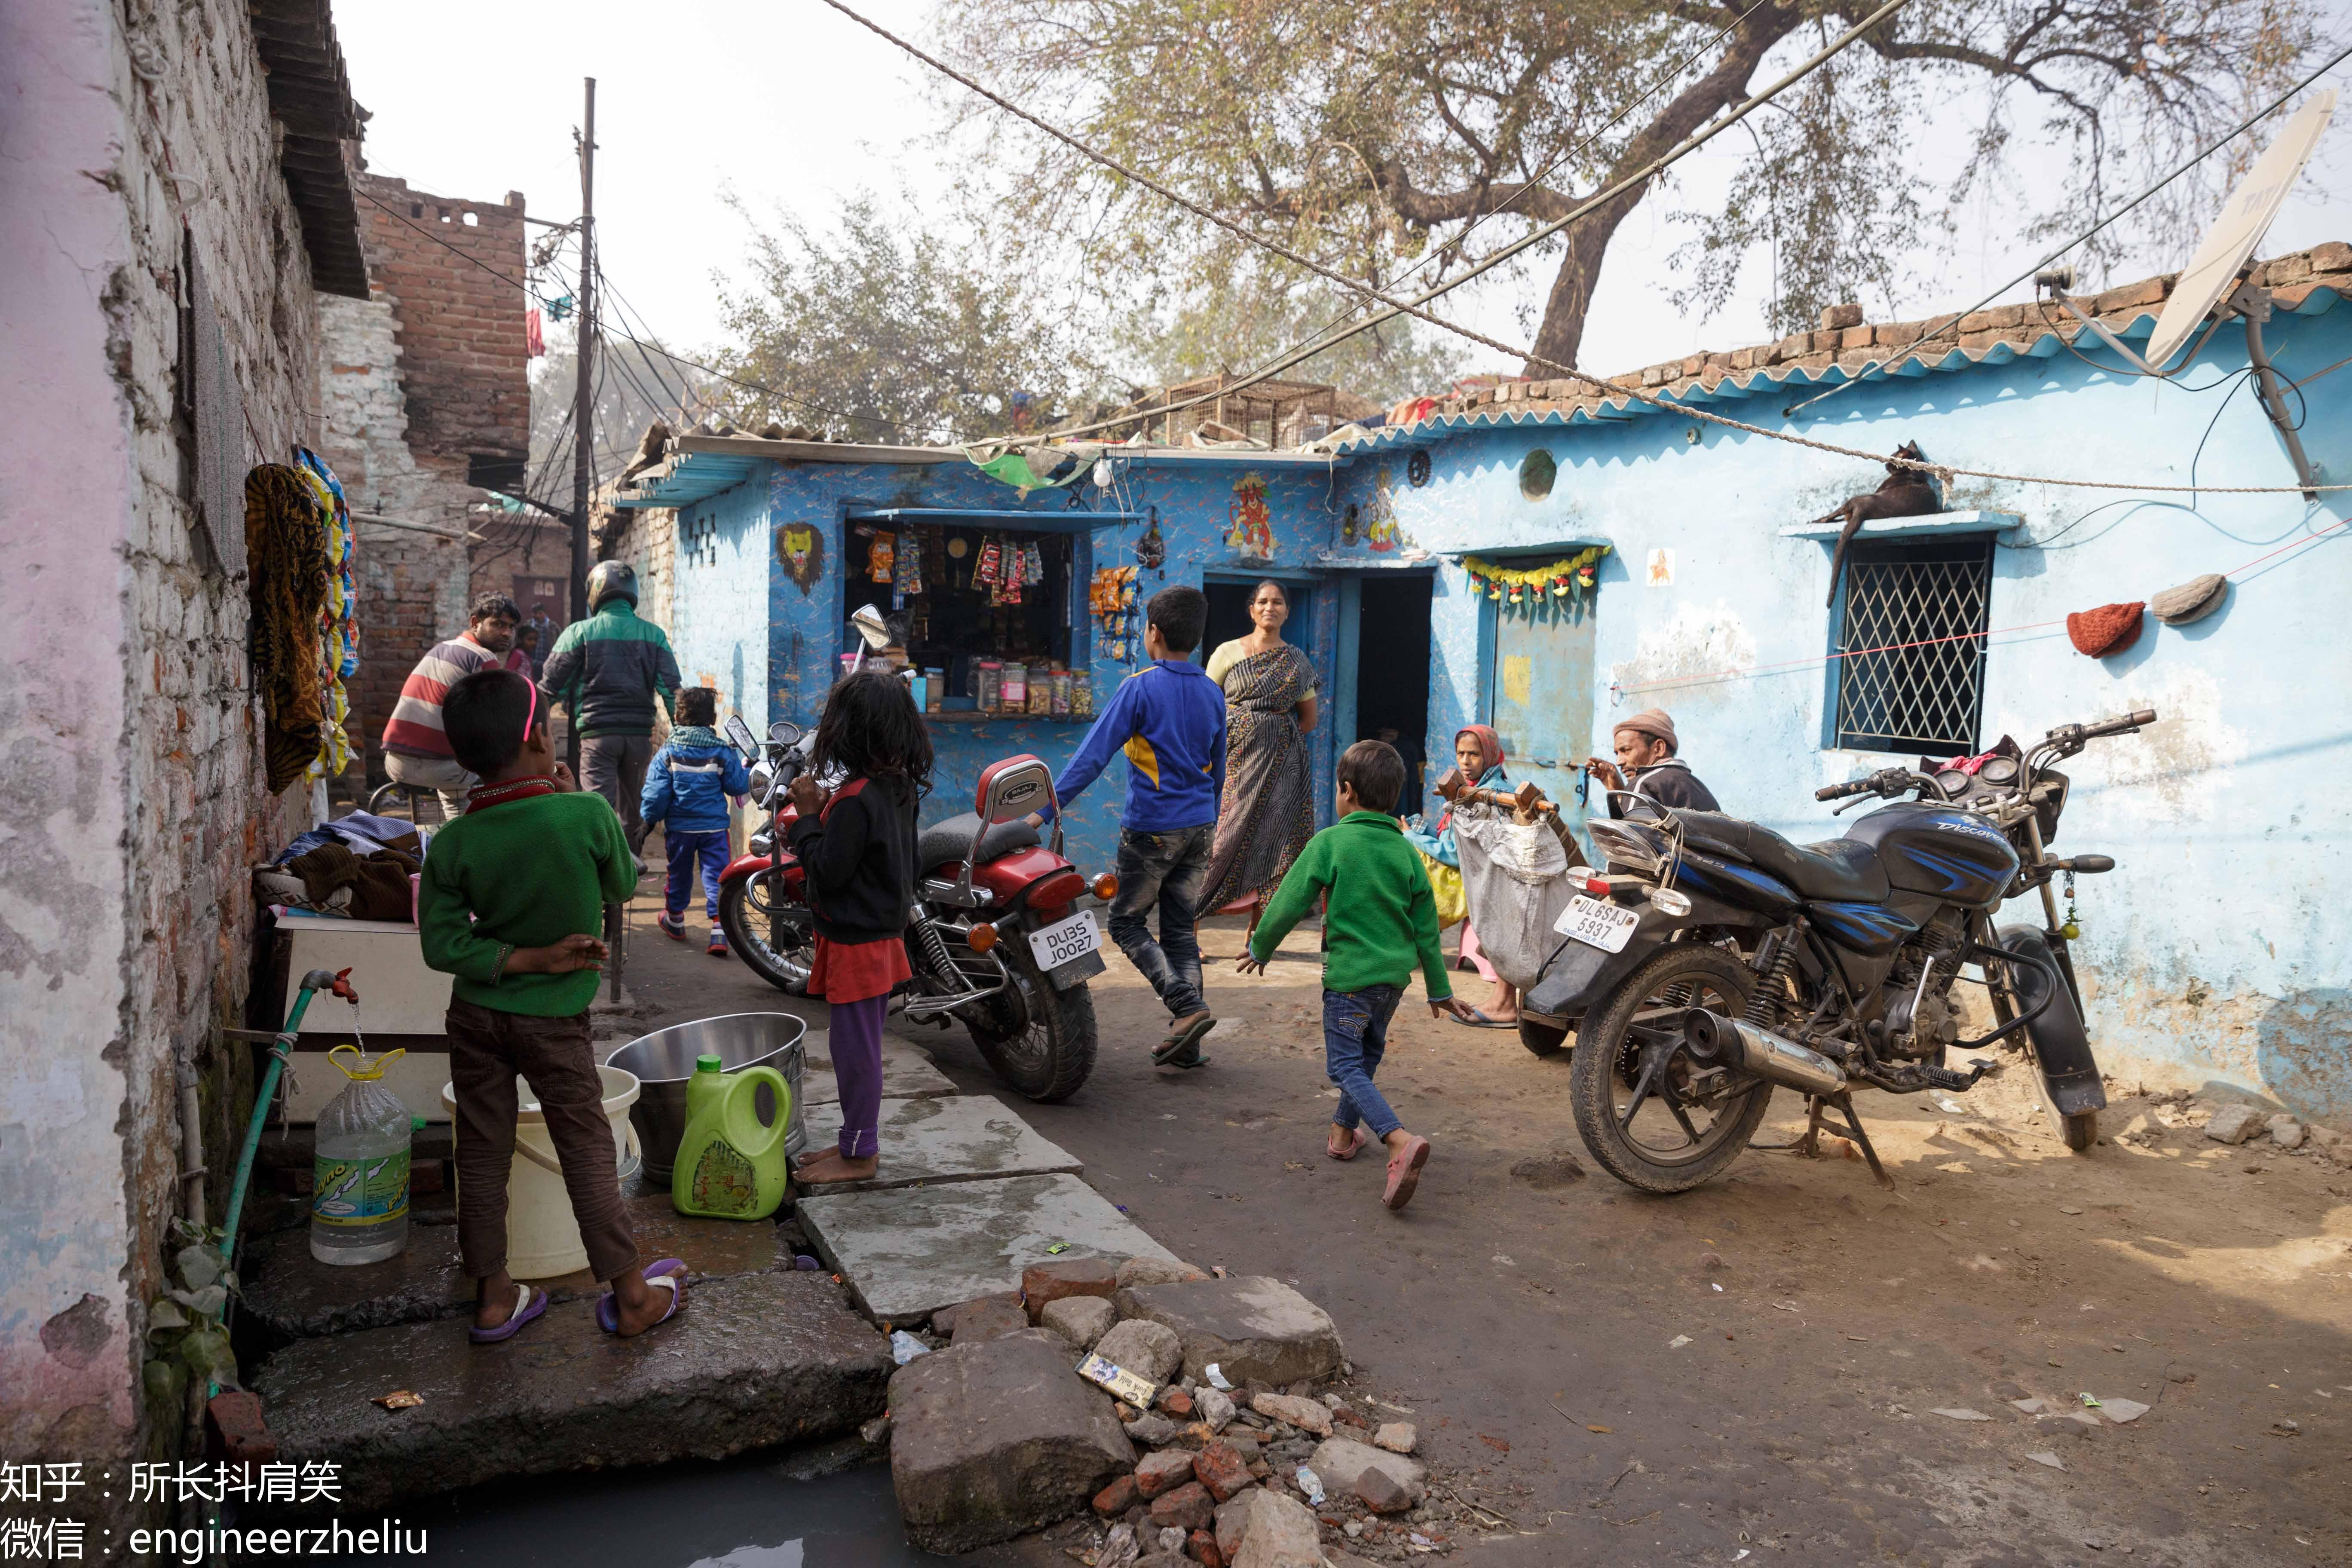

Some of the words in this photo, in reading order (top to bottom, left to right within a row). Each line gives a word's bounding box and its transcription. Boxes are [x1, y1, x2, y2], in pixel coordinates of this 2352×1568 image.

[1012, 785, 1032, 794] BAJAJ
[1936, 822, 2007, 843] Discover
[1577, 900, 1628, 926] DL6SAJ
[1577, 918, 1612, 940] 5937
[1118, 1375, 1133, 1387] Gold
[1133, 1381, 1147, 1396] Dark
